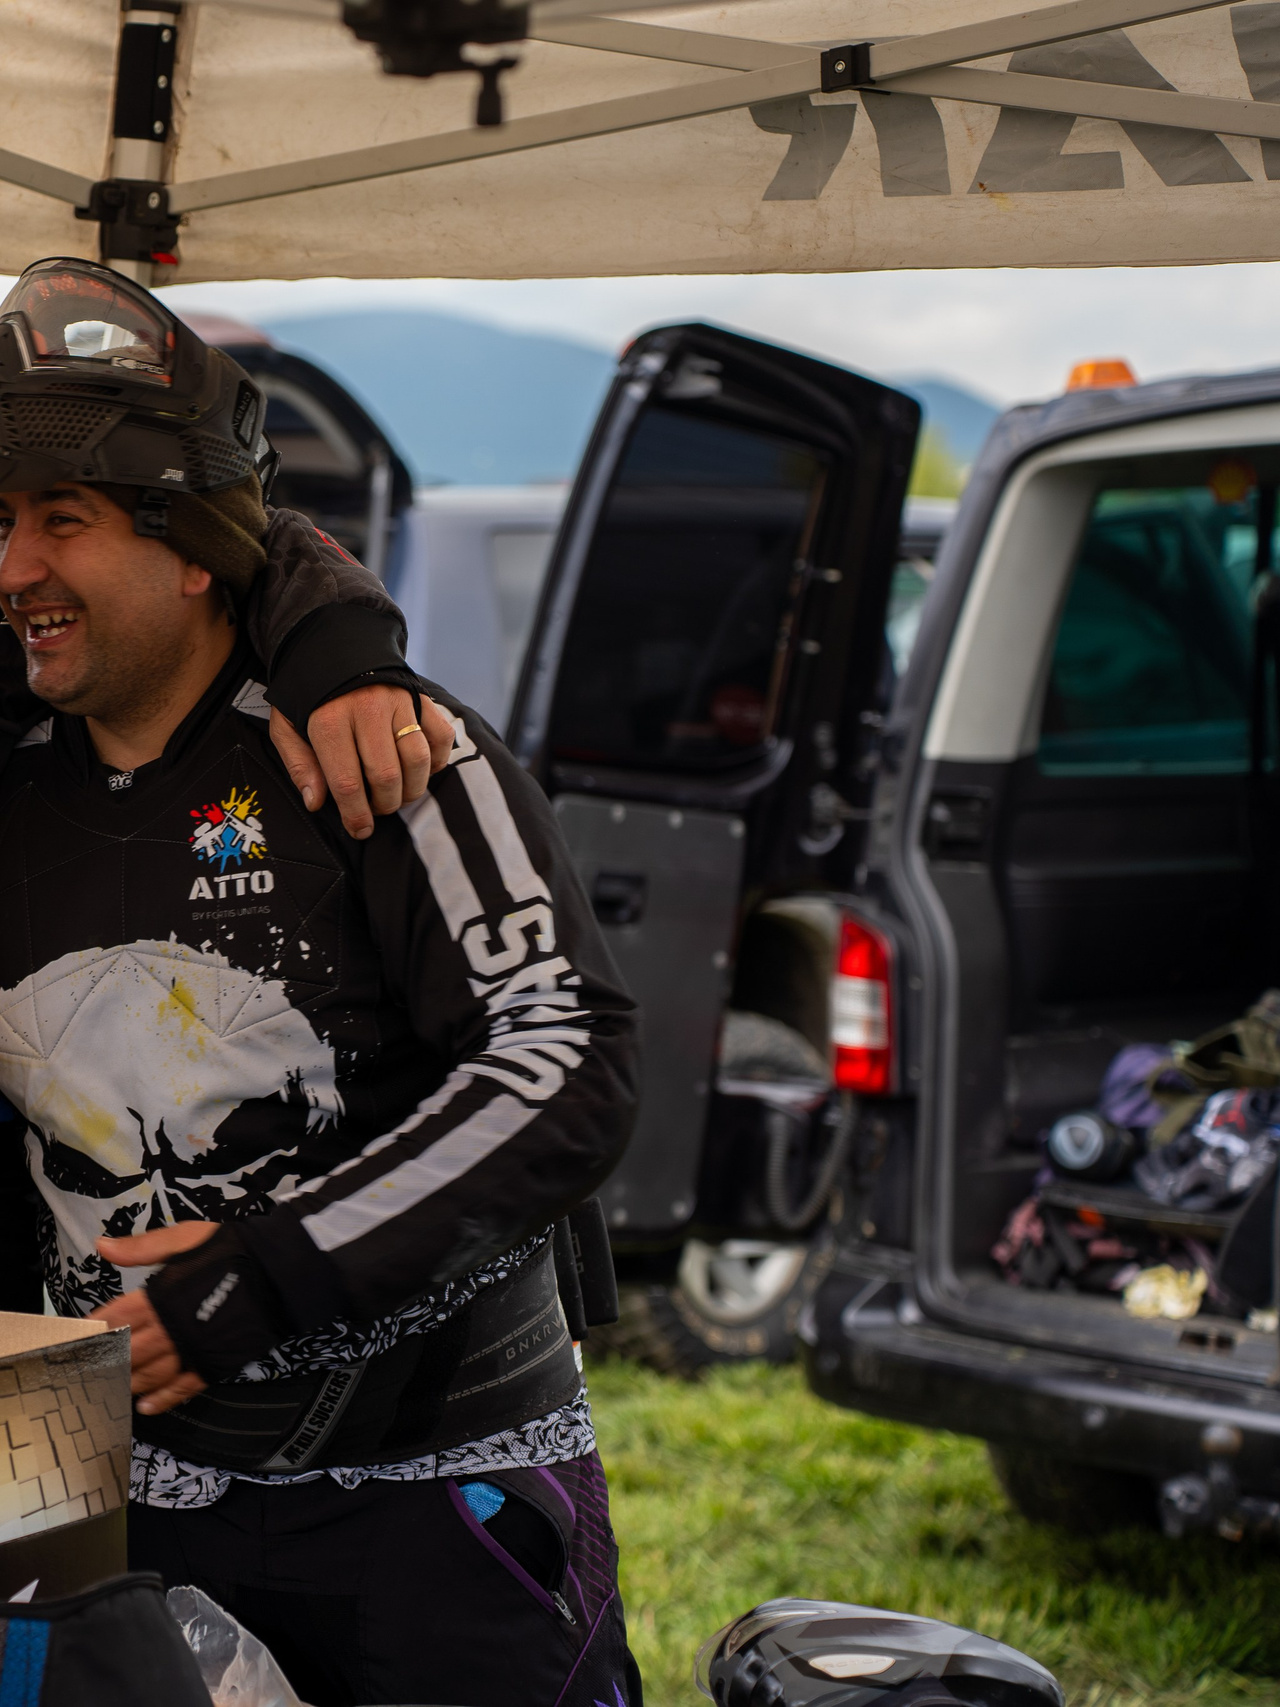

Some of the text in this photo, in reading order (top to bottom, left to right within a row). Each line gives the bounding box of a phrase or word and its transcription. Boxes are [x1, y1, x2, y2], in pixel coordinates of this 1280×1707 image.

[188, 869, 275, 901] ATTO
[191, 904, 271, 921] BY FORTIS UNITAS
